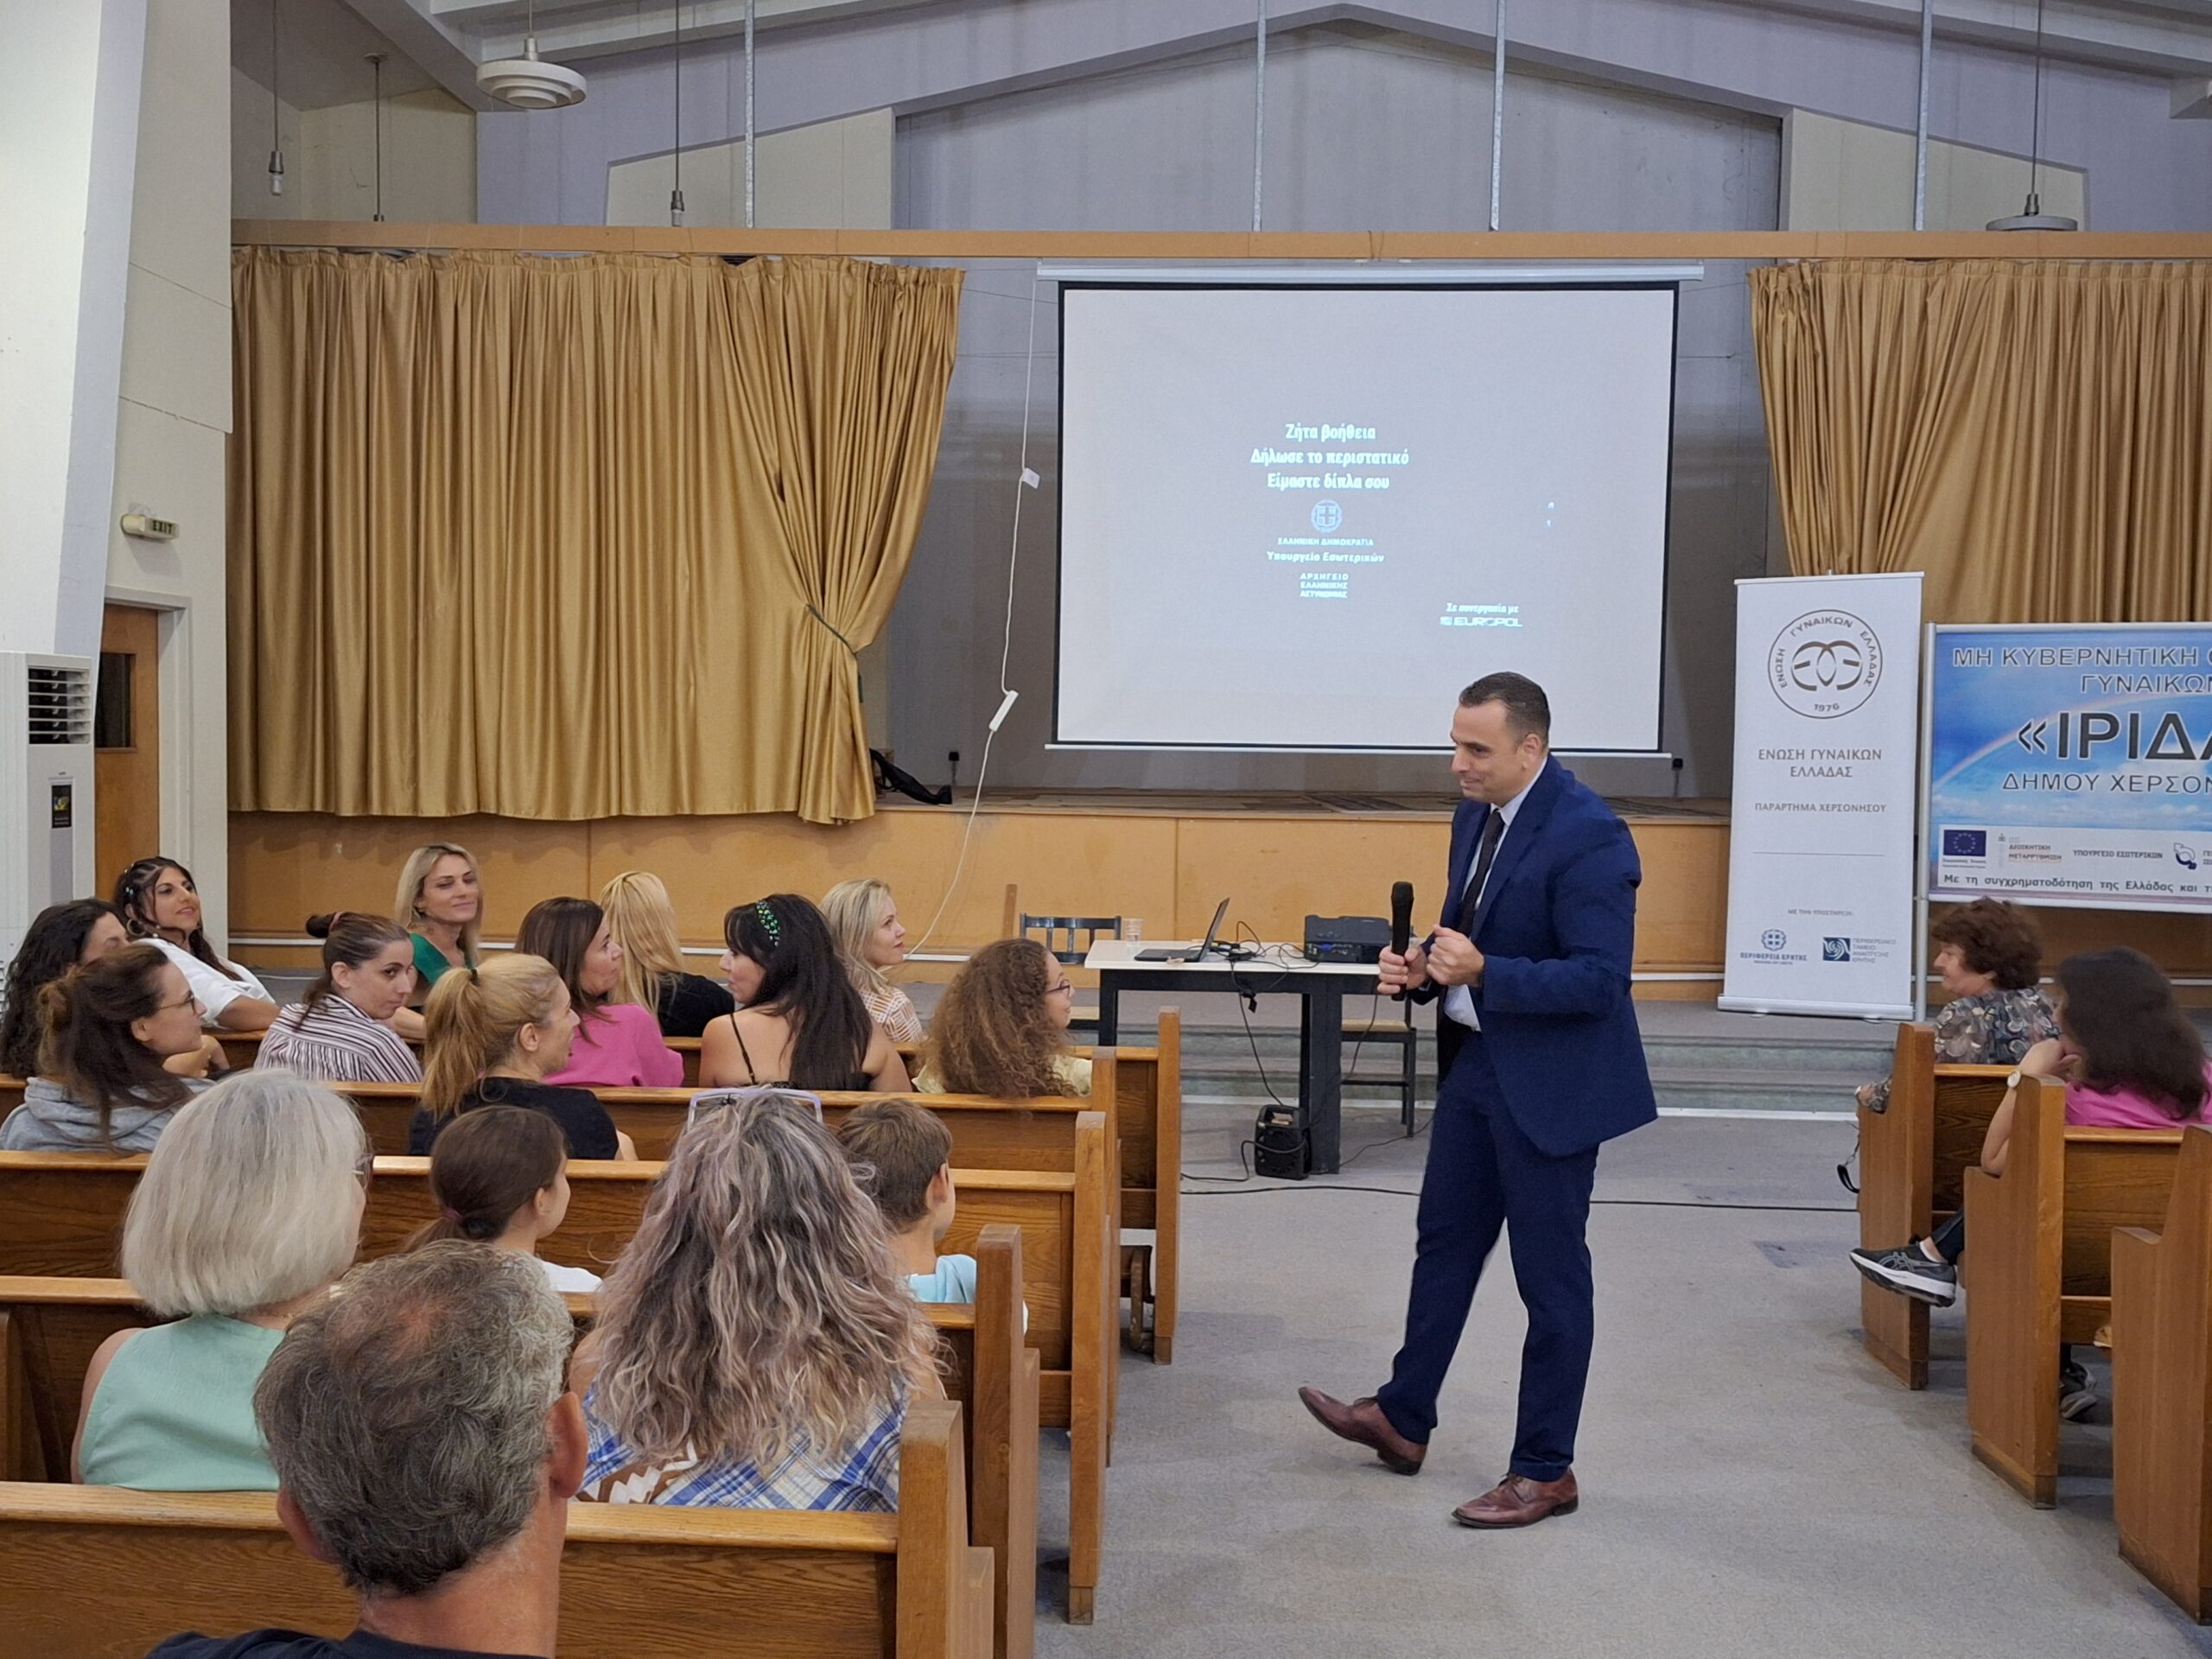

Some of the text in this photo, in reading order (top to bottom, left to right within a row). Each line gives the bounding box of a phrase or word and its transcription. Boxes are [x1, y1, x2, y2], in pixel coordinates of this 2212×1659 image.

[1285, 423, 1376, 442] Ζήτα βοήθεια
[1250, 447, 1409, 467] Δήλωσε το περιστατικό
[1268, 473, 1390, 491] Είμαστε δίπλα σου
[152, 519, 173, 535] EXIT
[1453, 617, 1523, 627] EUROPOL
[1776, 616, 1877, 689] ΕΝΩΣΗ ΓΥΝΑΙΚΩΝ ΕΛΛΑΔΑΣ
[1954, 647, 1993, 666] ΜΗ
[2002, 646, 2198, 667] ΚΥΒΕΡΝΗΤΙΚΗ
[2082, 674, 2212, 694] ΓΥΝΑΙΚΩ
[1814, 703, 1840, 712] 1976
[2018, 711, 2212, 760] «ΙΡΙΔ
[1758, 749, 1882, 760] ΕΝΩΣΗ ΓΥΝΑΙΚΩΝ
[1790, 766, 1853, 778] ΕΛΛΑΔΑΣ
[2002, 772, 2100, 791] ΔΗΜΟΥ
[1755, 803, 1886, 813] ΠΑΡΑΡΤΗΜΑ ΧΕΡΣΟΝΗΣΟΥ
[1944, 874, 1960, 883] Με
[1965, 876, 1978, 886] τη
[1985, 877, 2093, 891] συγχρηματοδότηση
[2100, 880, 2119, 891] της
[2126, 880, 2174, 893] Ελλάδας
[2180, 884, 2197, 893] και
